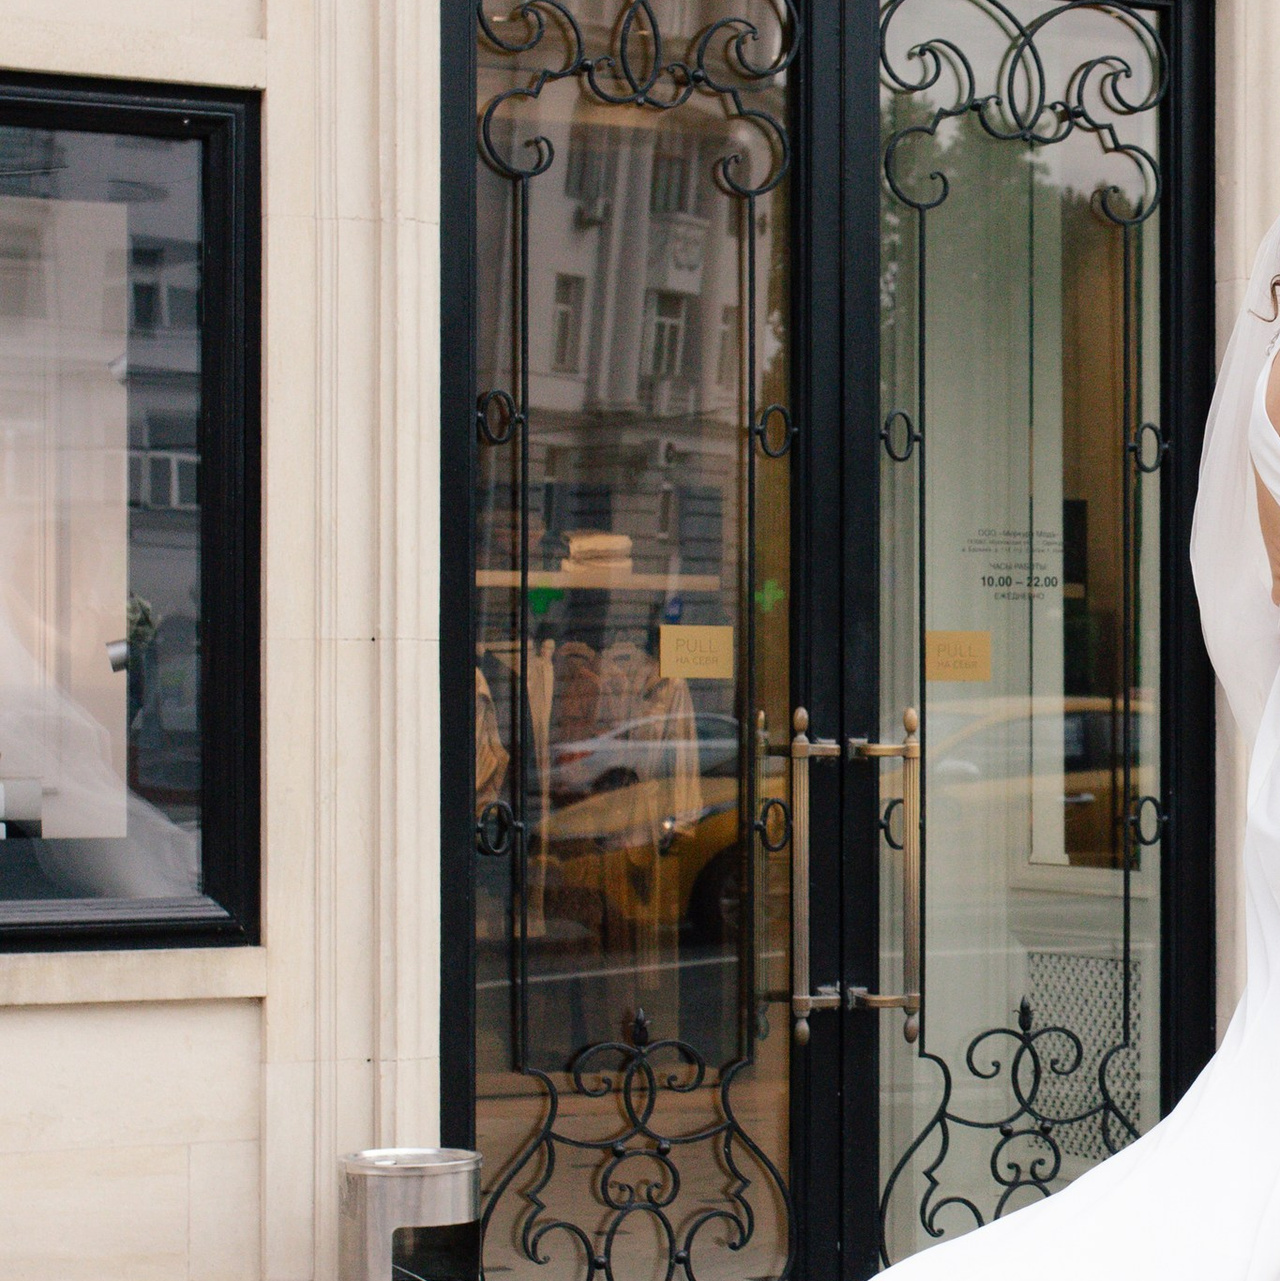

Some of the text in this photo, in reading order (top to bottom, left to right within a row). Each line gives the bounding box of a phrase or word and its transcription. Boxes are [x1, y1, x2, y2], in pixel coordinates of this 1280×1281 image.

[981, 575, 1013, 588] 10.00
[1026, 575, 1058, 588] 22.00
[994, 591, 1045, 600] ЕЖЕДНЕНО
[675, 638, 718, 653] PULL
[937, 643, 979, 658] PULL
